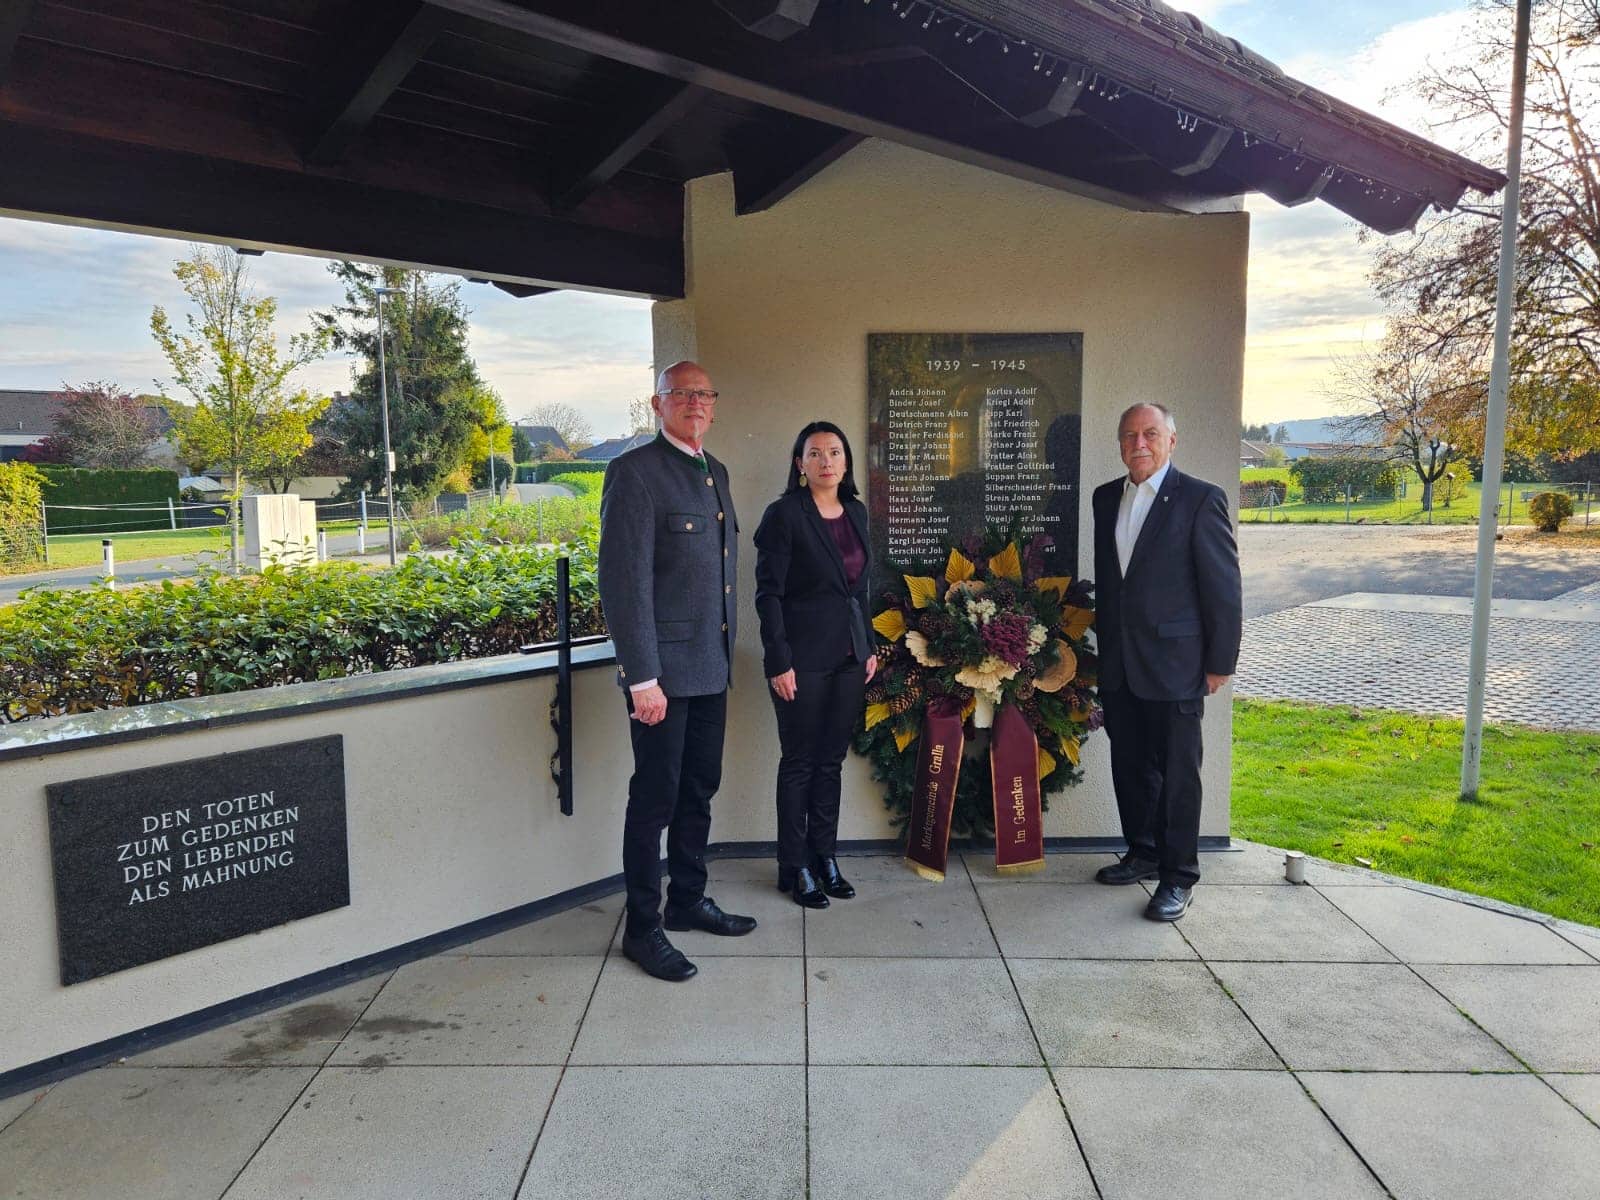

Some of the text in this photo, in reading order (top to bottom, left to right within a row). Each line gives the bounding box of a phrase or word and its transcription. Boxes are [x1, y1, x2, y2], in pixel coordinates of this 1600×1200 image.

[926, 360, 960, 370] 1939
[990, 360, 1026, 370] 1945
[916, 388, 946, 396] Johann
[1014, 387, 1038, 395] Adolf
[888, 399, 942, 407] Binder Josef
[1013, 398, 1036, 406] Adolf
[888, 410, 945, 418] Deutschmann
[1006, 409, 1023, 417] Karl
[1004, 420, 1040, 428] Friedrich
[923, 432, 964, 440] Ferdinand
[985, 473, 1015, 482] Suppan
[984, 484, 1047, 492] Silberschneider
[984, 515, 1029, 524] Vogeljer
[912, 537, 939, 545] Leopol
[928, 744, 944, 774] Gralla
[142, 790, 275, 834] DEN TOTEN
[1012, 776, 1026, 844] Im Gedenken
[117, 806, 300, 862] ZUM GEDENKEN
[124, 829, 295, 884] DEN LEBENDEN
[128, 851, 294, 906] ALS MAHNUNG
